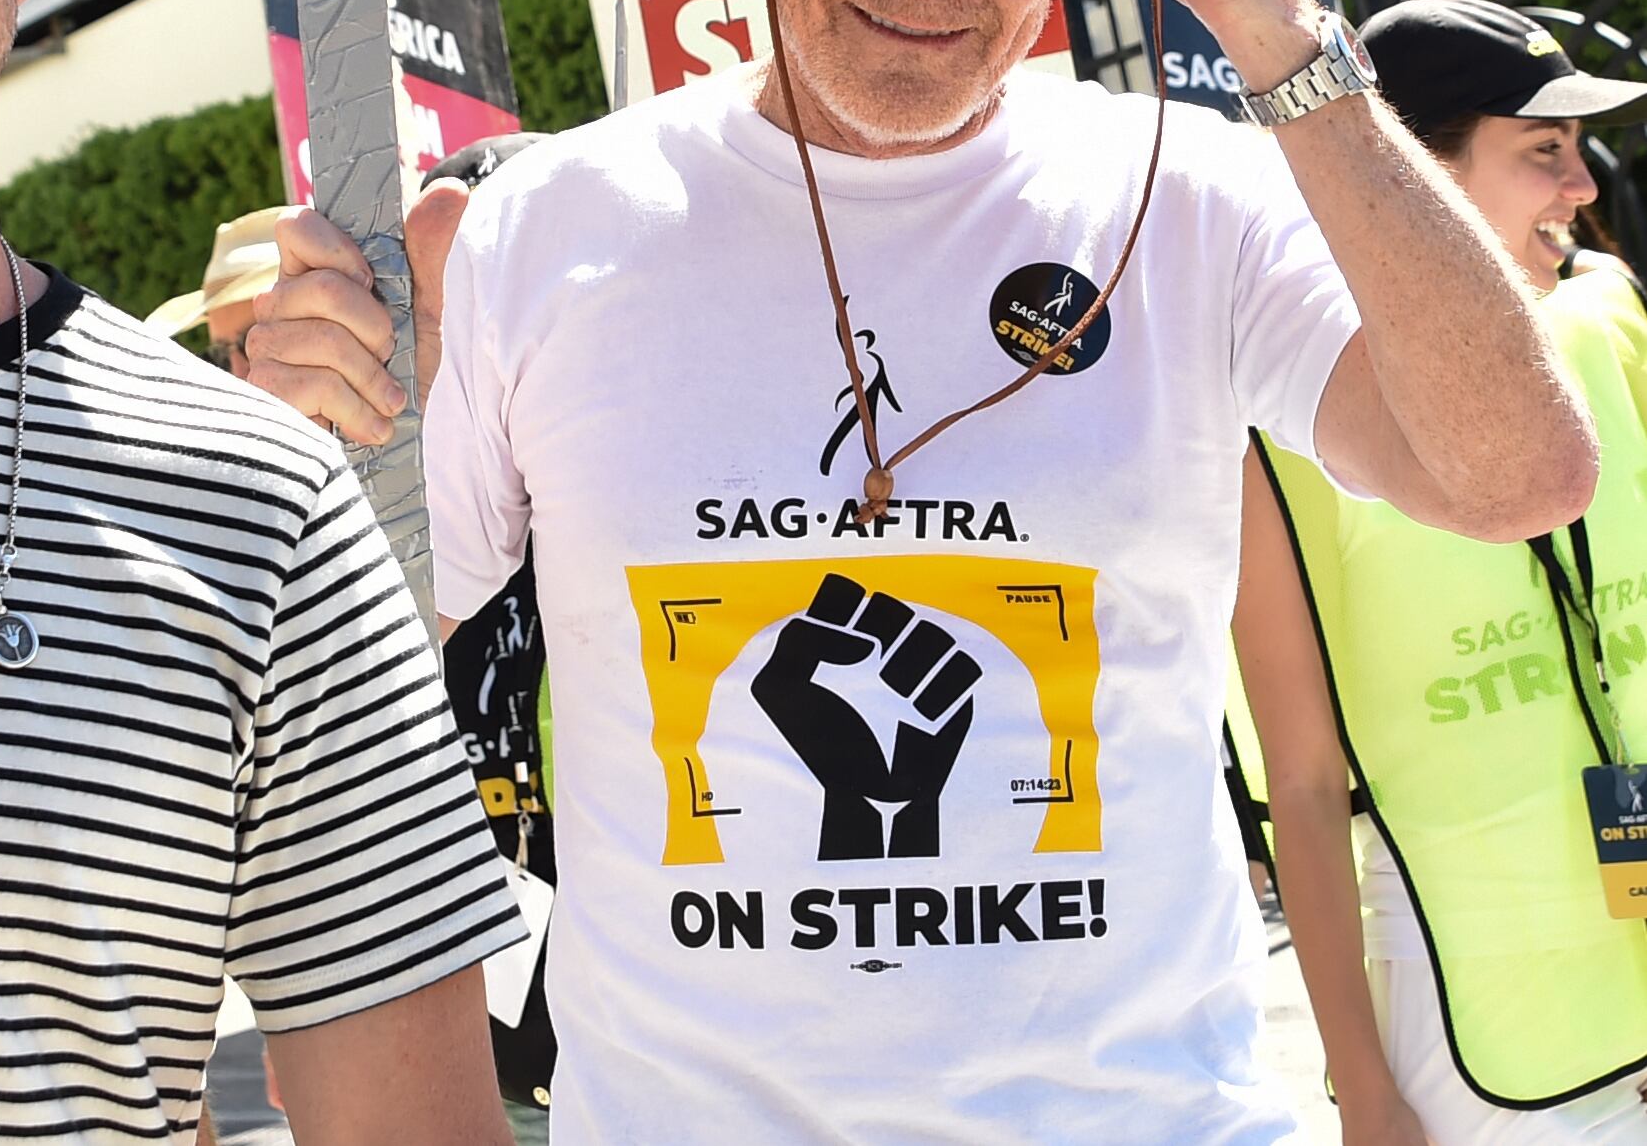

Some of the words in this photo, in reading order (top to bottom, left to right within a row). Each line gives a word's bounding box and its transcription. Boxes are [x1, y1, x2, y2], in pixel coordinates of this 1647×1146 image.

[1005, 594, 1052, 604] PAUSE
[670, 888, 765, 950] ON
[790, 878, 1108, 948] STRIKE!
